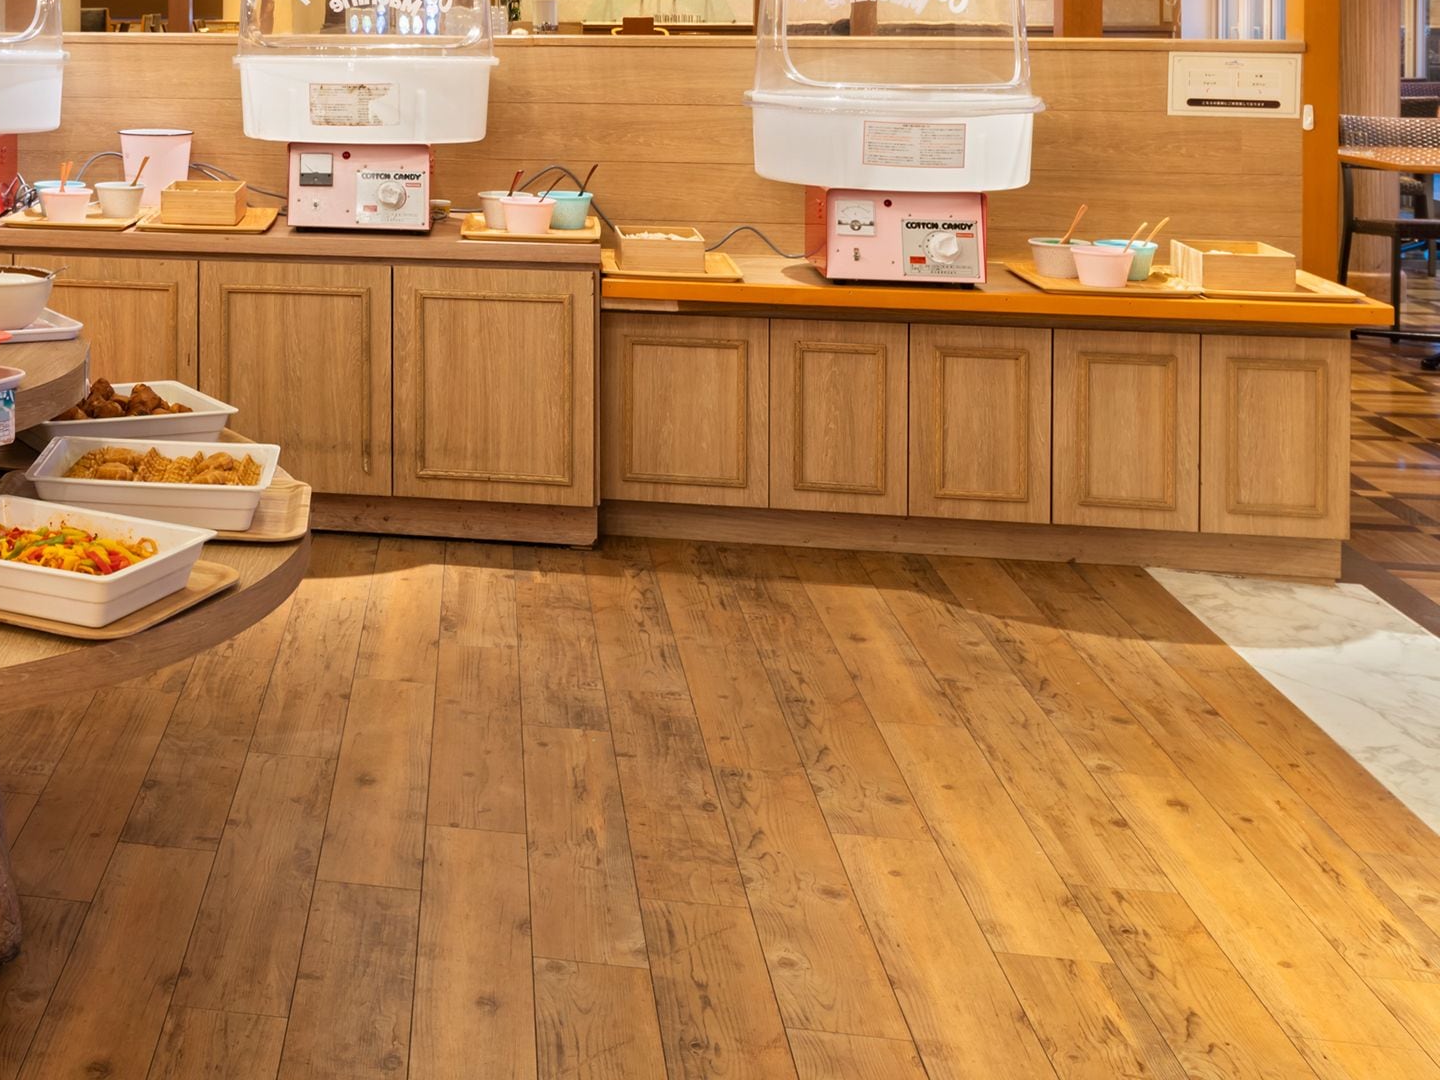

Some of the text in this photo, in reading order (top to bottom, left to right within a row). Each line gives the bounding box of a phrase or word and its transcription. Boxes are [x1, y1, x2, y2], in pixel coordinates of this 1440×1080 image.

[361, 172, 422, 181] COTTON CANDY
[905, 221, 974, 231] COTTON CANDY
